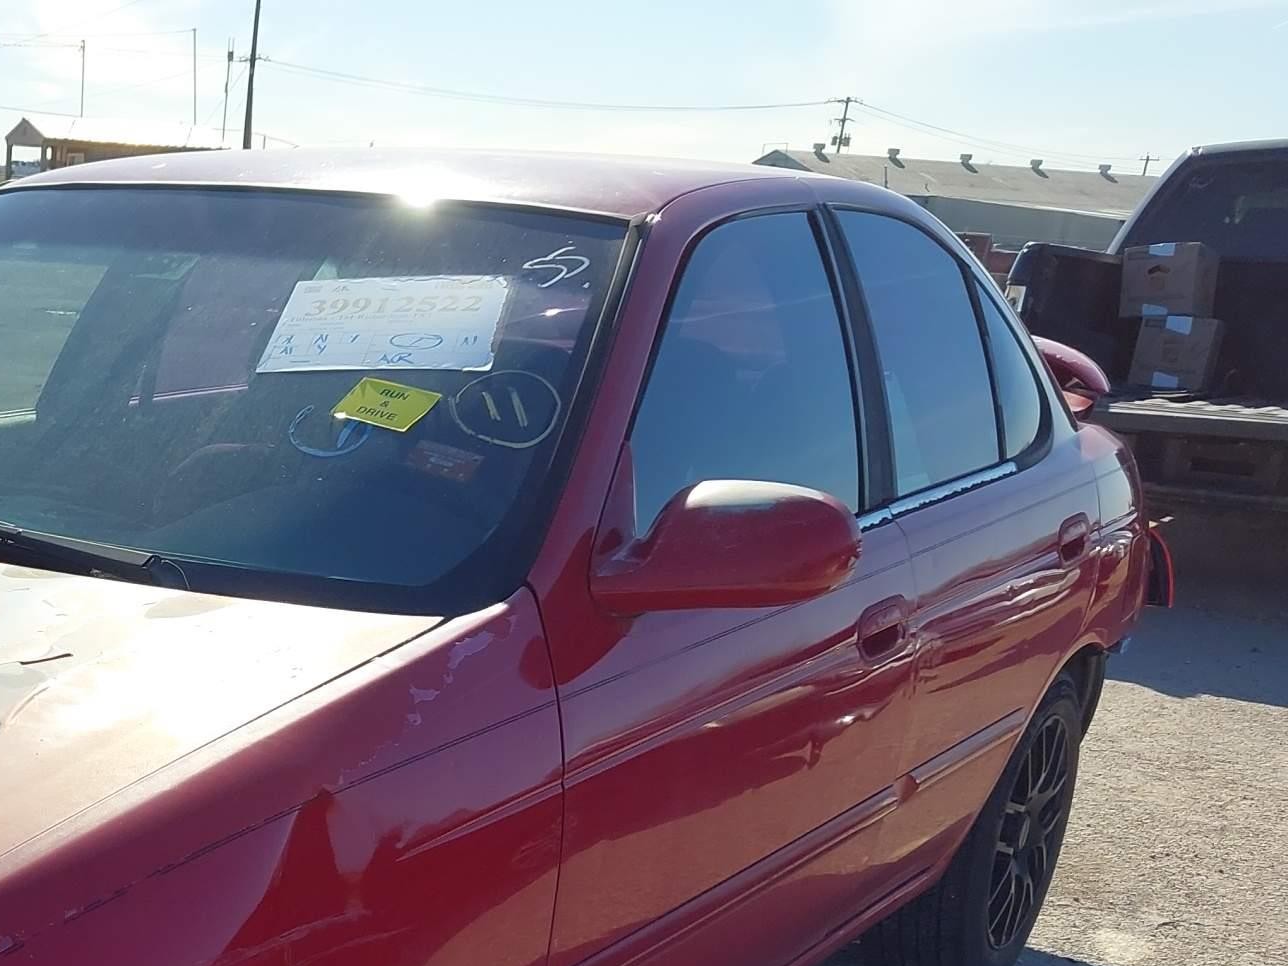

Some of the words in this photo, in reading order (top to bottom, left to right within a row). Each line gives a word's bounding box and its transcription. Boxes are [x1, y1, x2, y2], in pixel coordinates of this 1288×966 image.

[305, 296, 482, 316] 39912522
[379, 388, 411, 401] RUN
[380, 400, 389, 408] &
[356, 406, 398, 422] DRIVE
